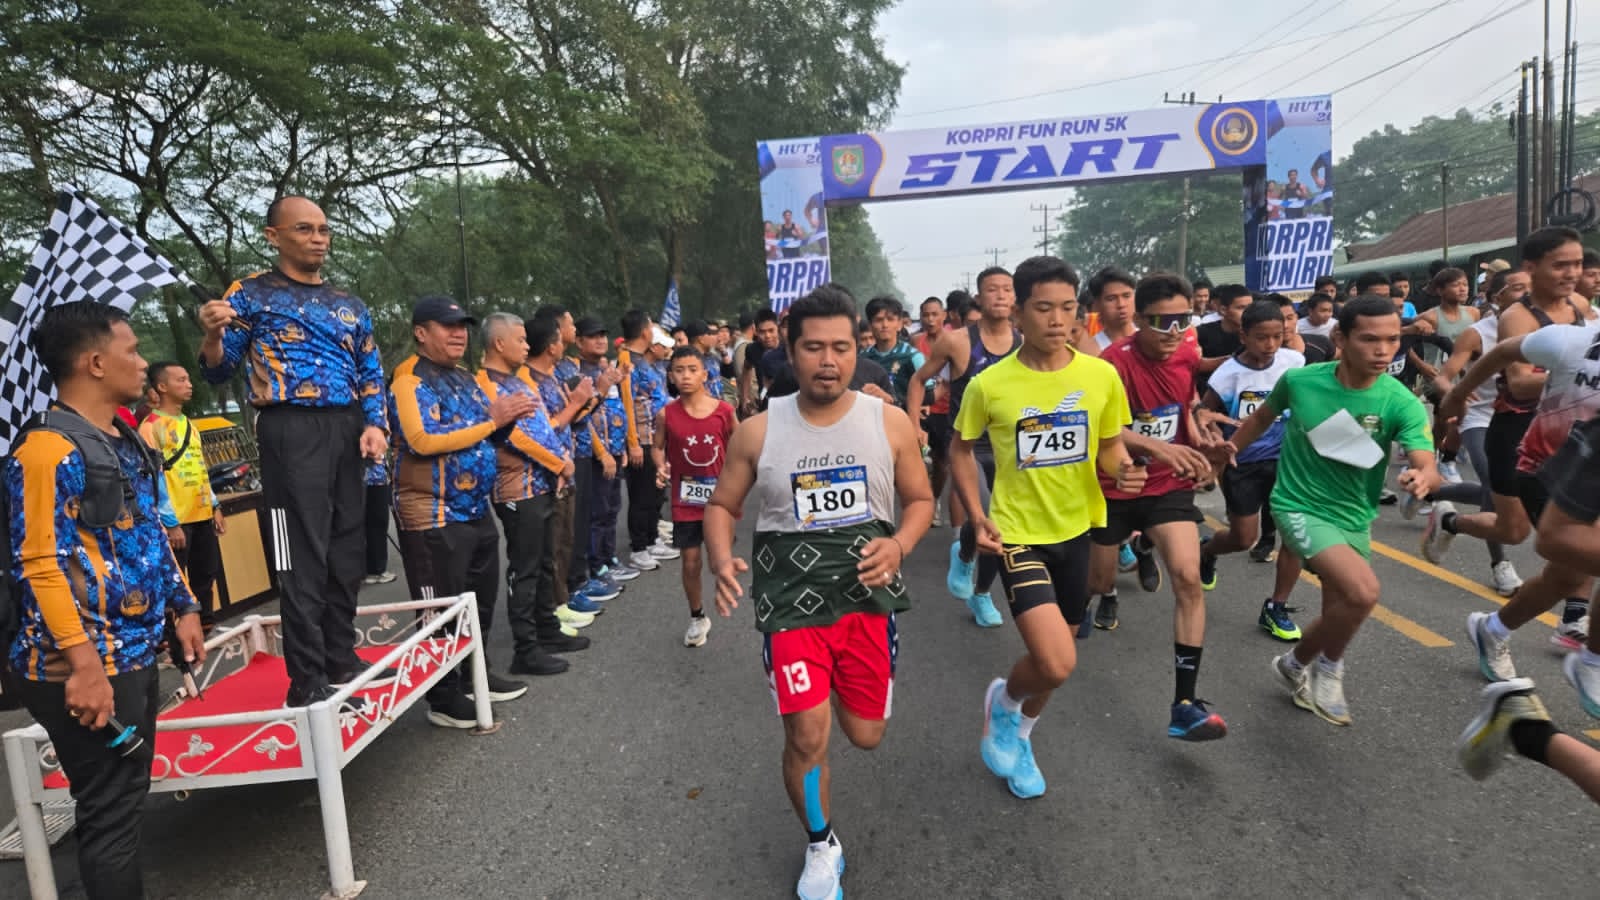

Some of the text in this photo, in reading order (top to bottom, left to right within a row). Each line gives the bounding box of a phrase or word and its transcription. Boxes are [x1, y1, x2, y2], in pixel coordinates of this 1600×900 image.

[946, 115, 1128, 146] KORPRI FUN RUN 5K
[899, 133, 1181, 190] START
[1140, 420, 1173, 437] 847
[1028, 431, 1076, 454] 748
[796, 452, 856, 469] dnd.co
[686, 485, 713, 499] 280
[806, 488, 856, 513] 180
[782, 660, 811, 695] 13
